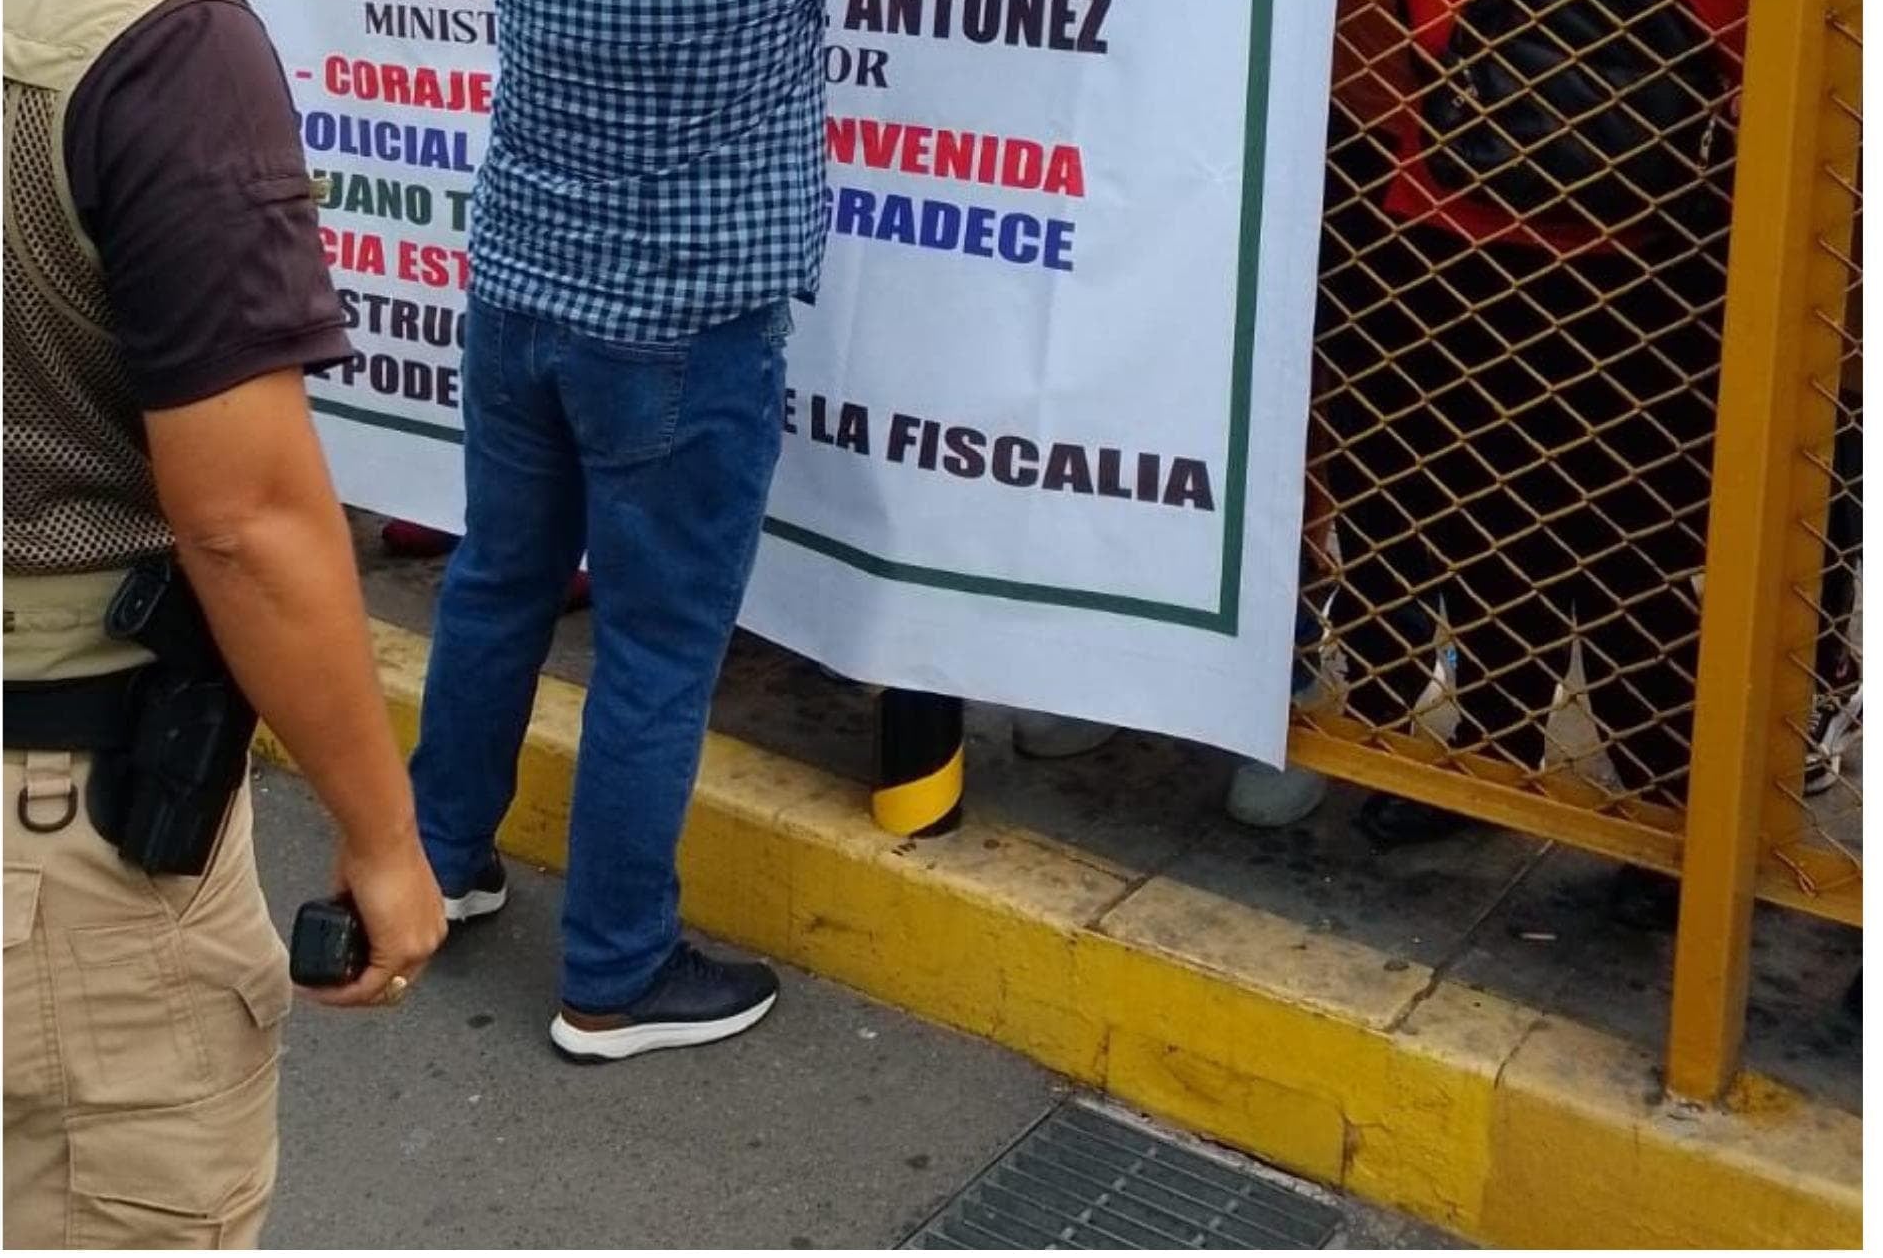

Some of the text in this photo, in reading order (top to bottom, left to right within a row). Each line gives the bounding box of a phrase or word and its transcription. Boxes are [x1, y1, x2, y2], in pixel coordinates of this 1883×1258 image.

[324, 55, 492, 114] CORAJE
[300, 110, 475, 173] OLICIAL
[811, 394, 869, 456] LA
[886, 411, 1215, 512] FISCALIA
